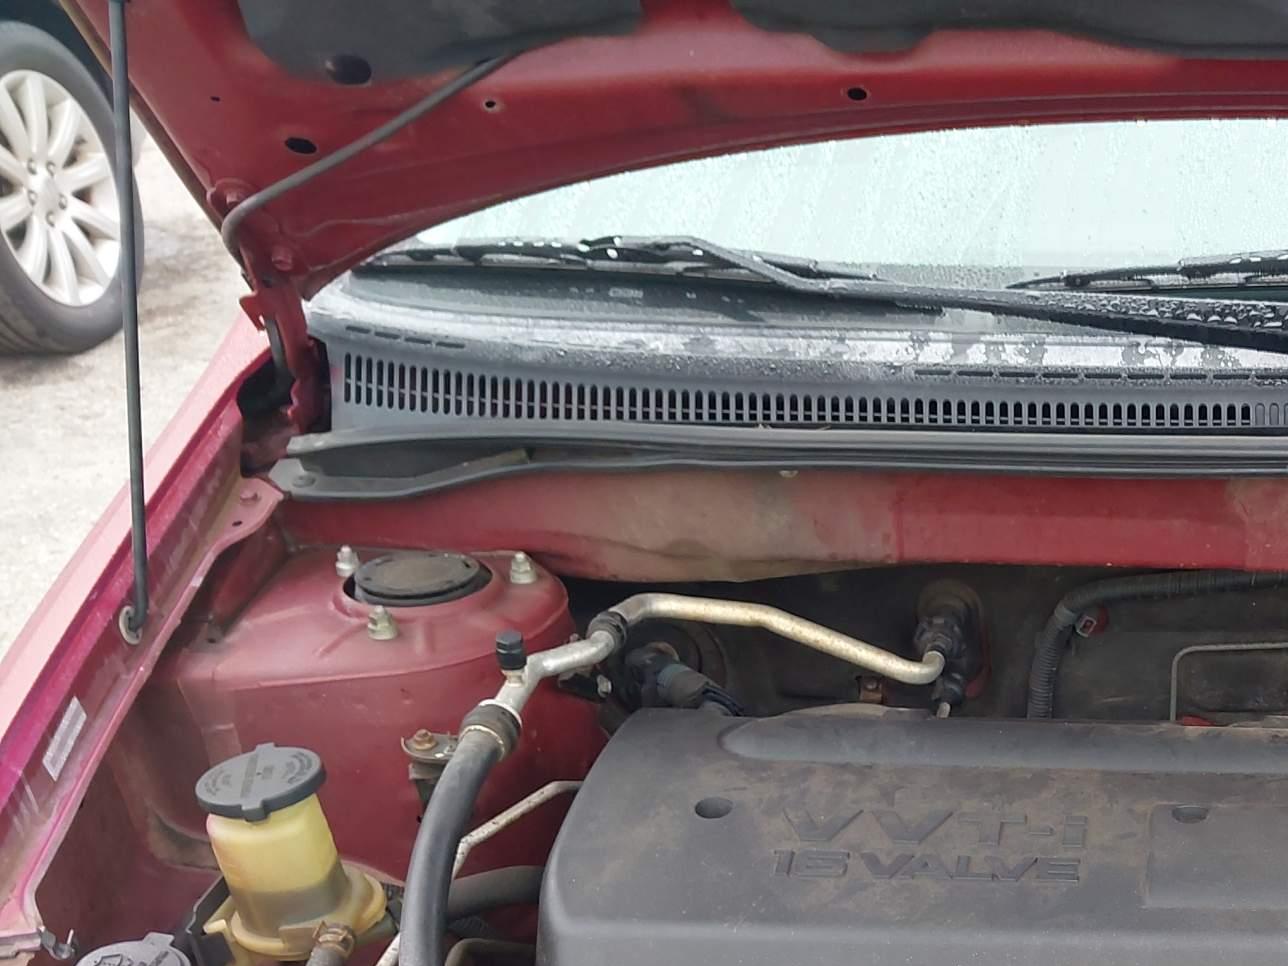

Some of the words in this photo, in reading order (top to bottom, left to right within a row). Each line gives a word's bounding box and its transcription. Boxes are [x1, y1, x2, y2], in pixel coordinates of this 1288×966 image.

[782, 808, 1089, 849] VVT-i
[770, 848, 851, 878] 16
[860, 853, 1081, 883] VALVE
